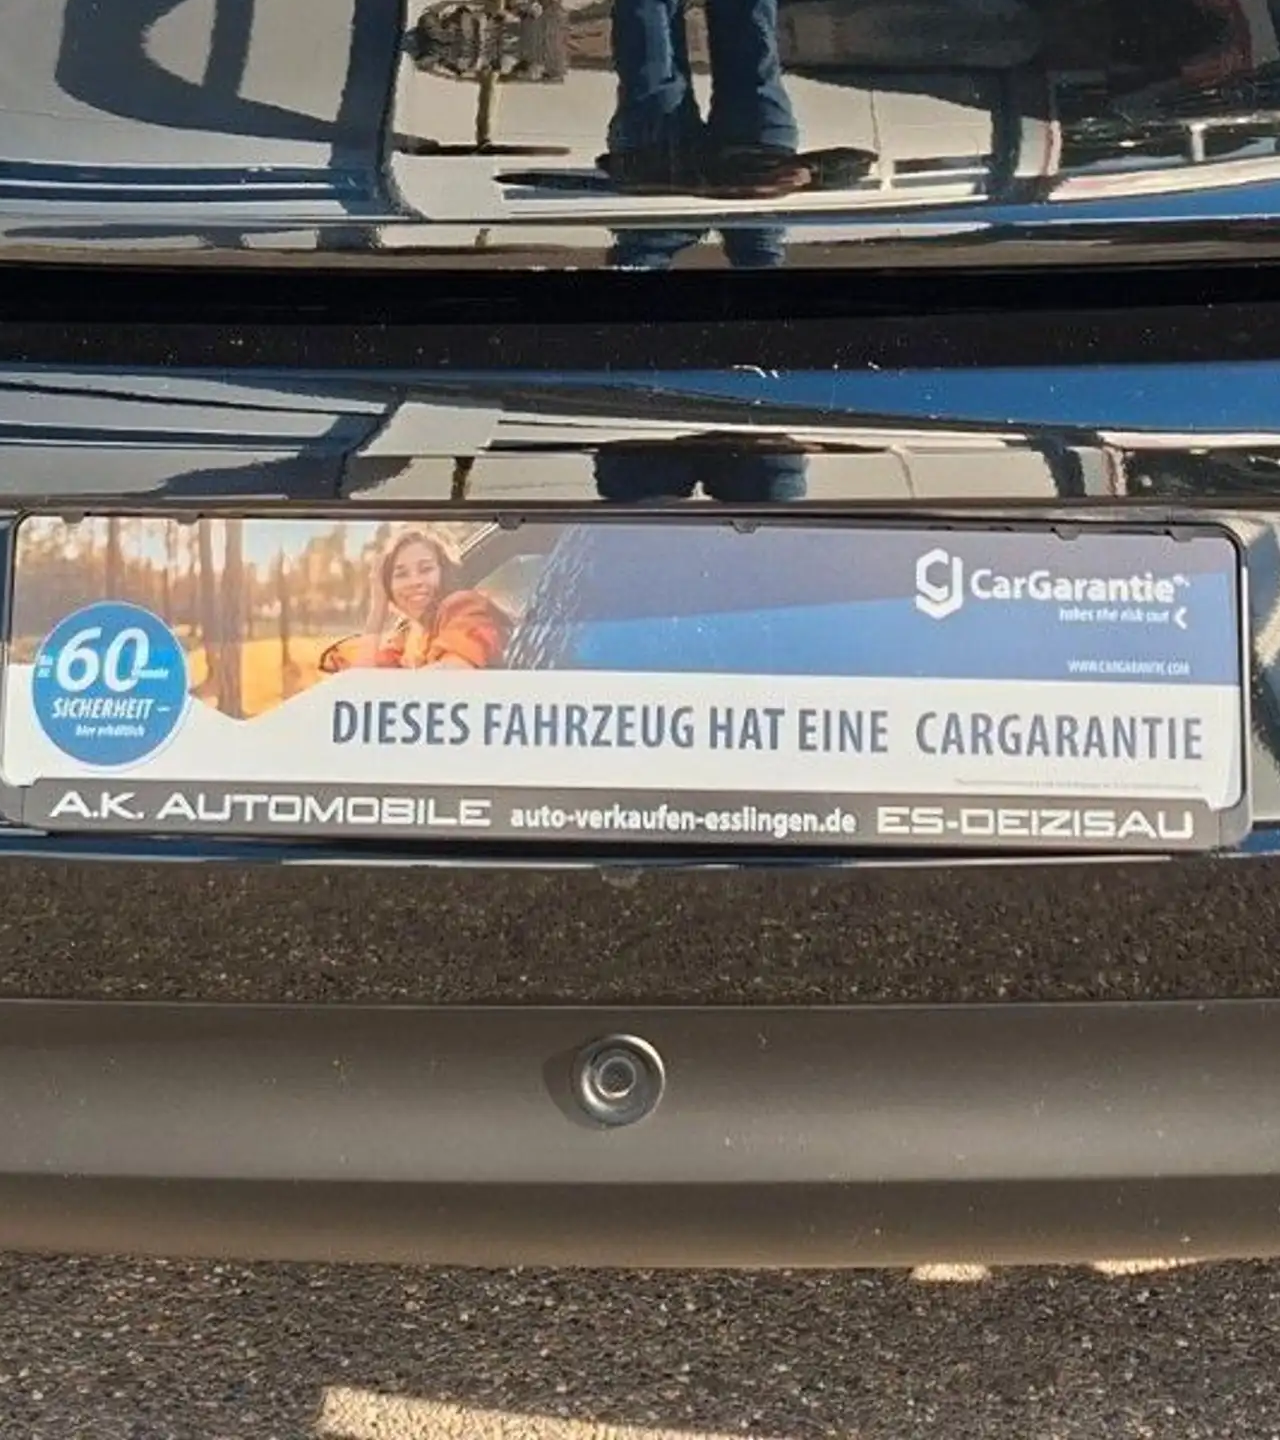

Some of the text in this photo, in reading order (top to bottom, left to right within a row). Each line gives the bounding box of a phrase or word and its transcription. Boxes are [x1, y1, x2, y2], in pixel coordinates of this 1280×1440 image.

[970, 568, 1176, 603] CarGarantie
[56, 626, 150, 693] 60
[52, 697, 155, 719] SICHERHEIT
[332, 700, 1203, 760] DIESES FAHRZEUG HAT EINE CARGARANTIE
[49, 790, 1194, 840] A.K. AUTOMOBILE auto-verkaufen-esslingen.de ES-DEIZISAU
